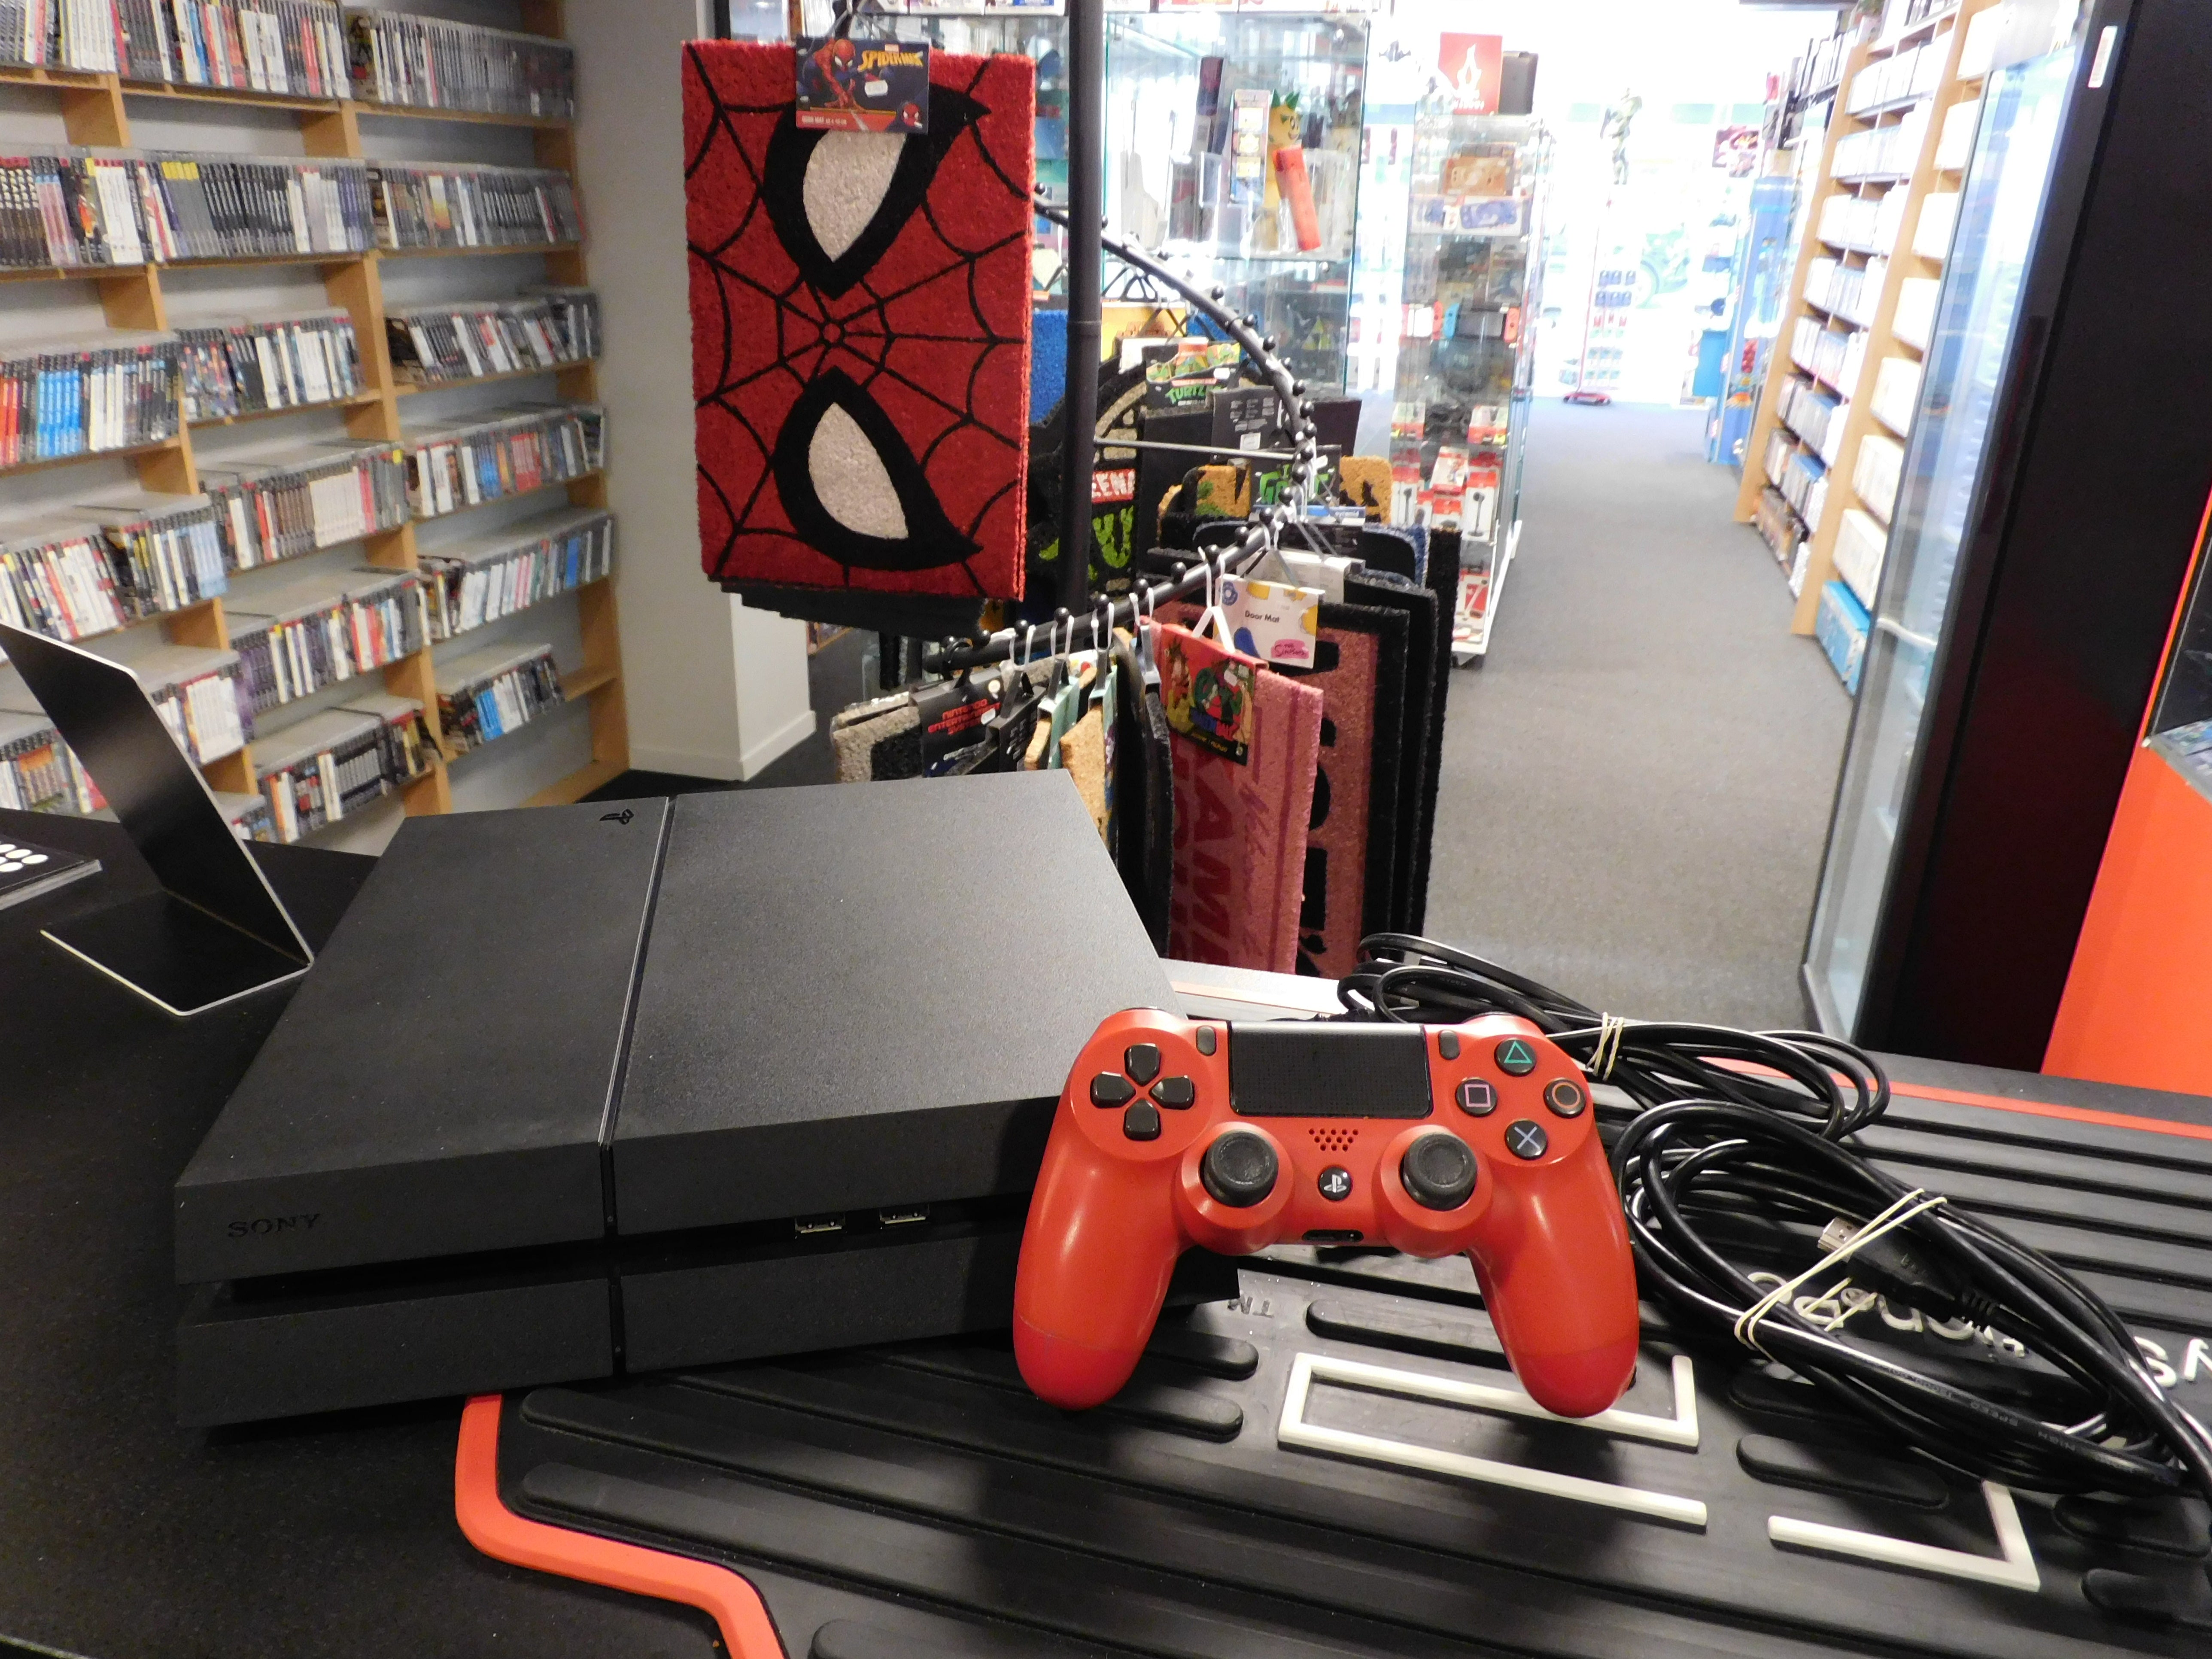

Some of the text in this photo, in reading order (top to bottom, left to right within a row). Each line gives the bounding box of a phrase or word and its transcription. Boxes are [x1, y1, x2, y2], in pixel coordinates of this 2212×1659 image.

[1245, 610, 1280, 623] Door Mat
[228, 1213, 321, 1237] SONY
